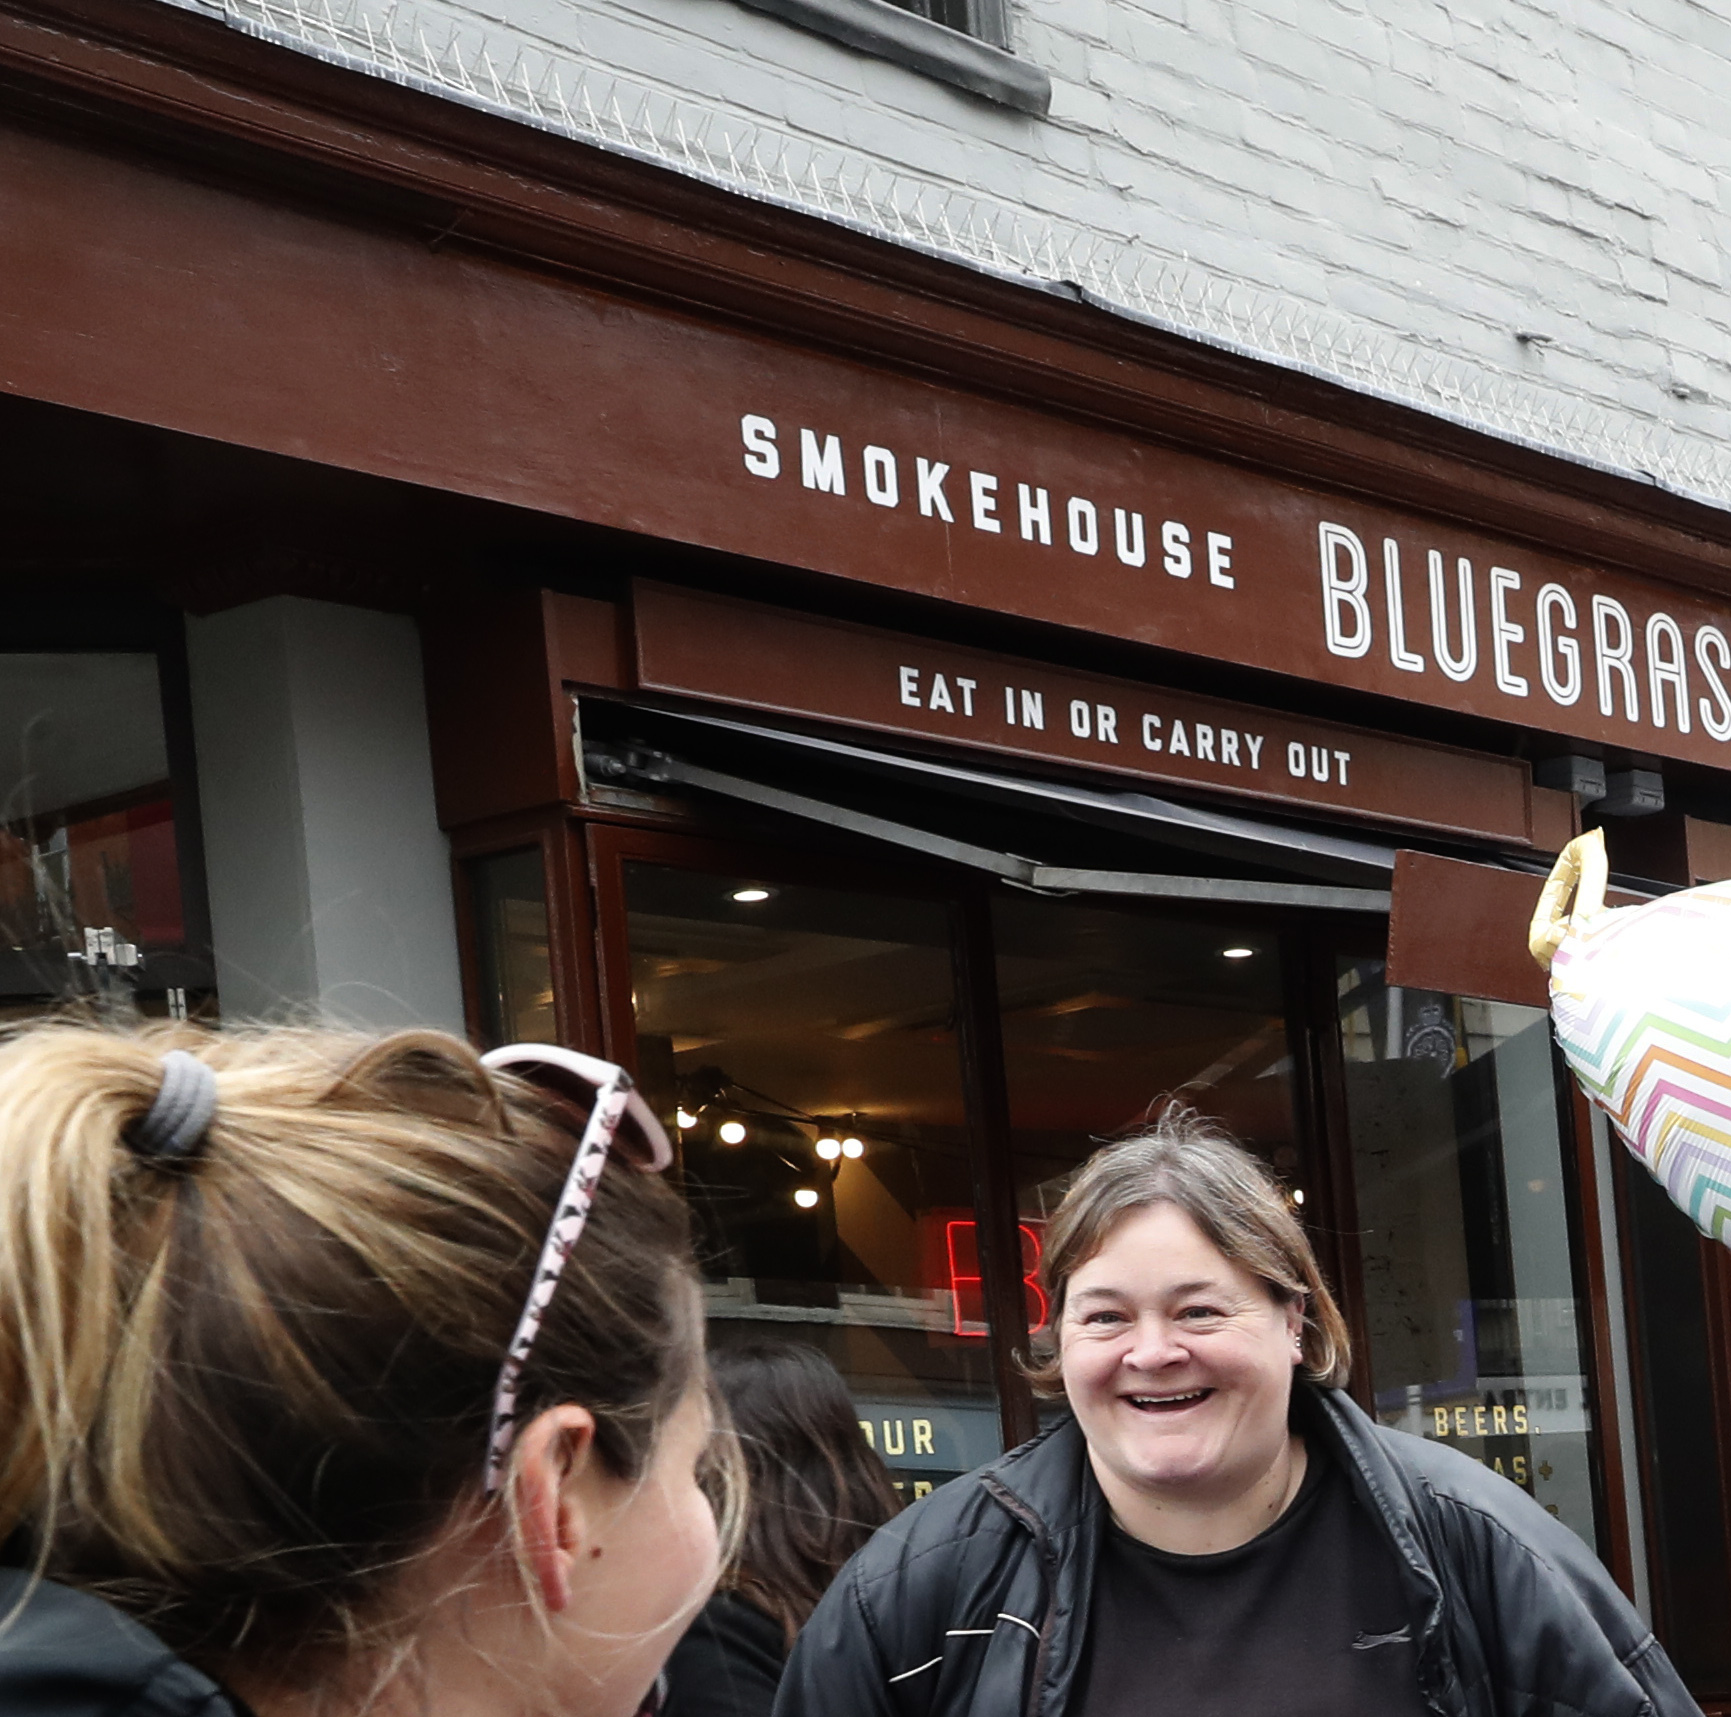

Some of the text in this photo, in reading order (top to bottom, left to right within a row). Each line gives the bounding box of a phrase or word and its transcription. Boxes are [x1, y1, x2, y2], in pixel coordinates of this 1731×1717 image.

[740, 413, 1235, 589] SMOKEHOUSE
[899, 665, 1351, 786] EAT IN OR CARRY OUT
